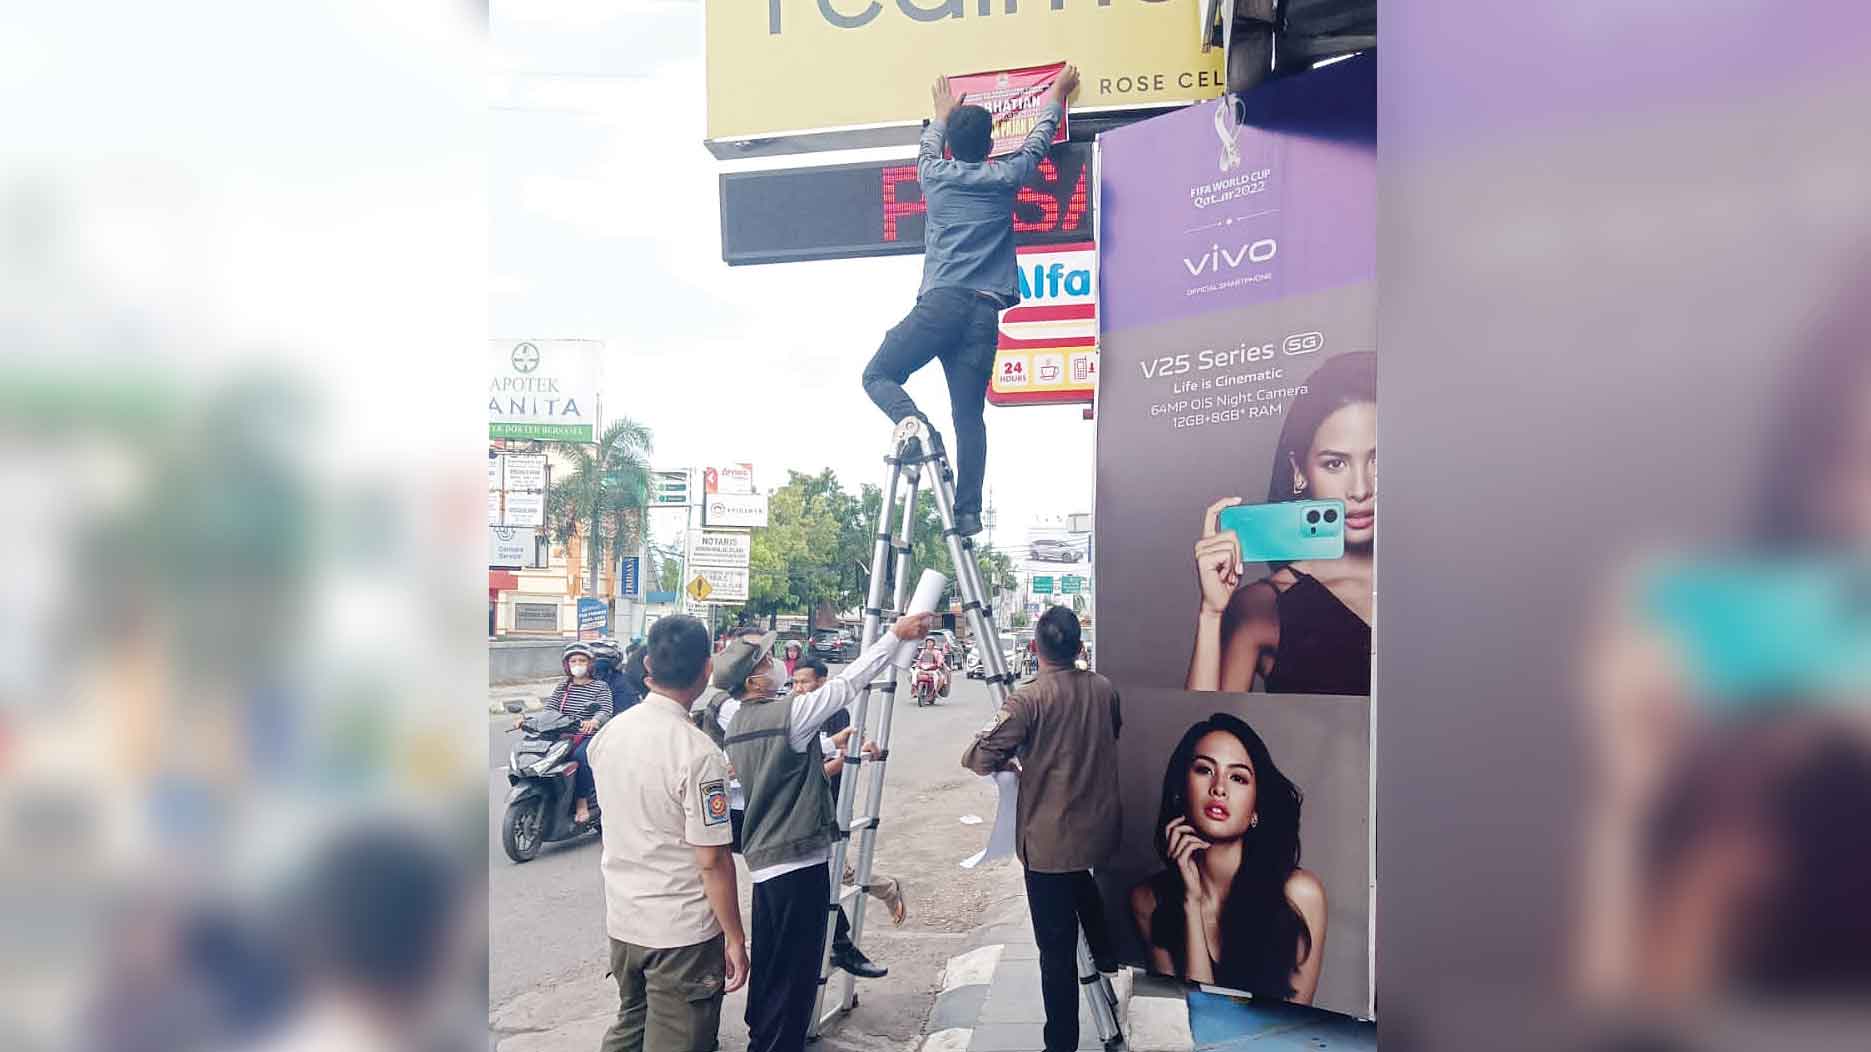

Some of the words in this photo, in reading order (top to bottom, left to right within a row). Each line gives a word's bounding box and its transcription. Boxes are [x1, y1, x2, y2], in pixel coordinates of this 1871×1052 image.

[1100, 74, 1165, 95] ROSE
[1190, 183, 1212, 199] FIFA
[1211, 174, 1250, 192] WORLD
[1250, 168, 1271, 182] CUP
[1183, 239, 1277, 276] vivo
[1004, 361, 1023, 374] 24
[1139, 353, 1191, 379] V25
[1198, 343, 1274, 370] Series
[489, 376, 560, 393] APOTEK
[1000, 374, 1026, 383] HOURS
[1173, 379, 1198, 394] Life
[1201, 377, 1212, 390] is
[1215, 367, 1283, 388] Cinematic
[1150, 400, 1188, 416] 64MP
[1191, 398, 1213, 411] OIS
[1216, 391, 1252, 408] Night
[1257, 384, 1309, 401] Camera
[1249, 404, 1282, 419] RAM
